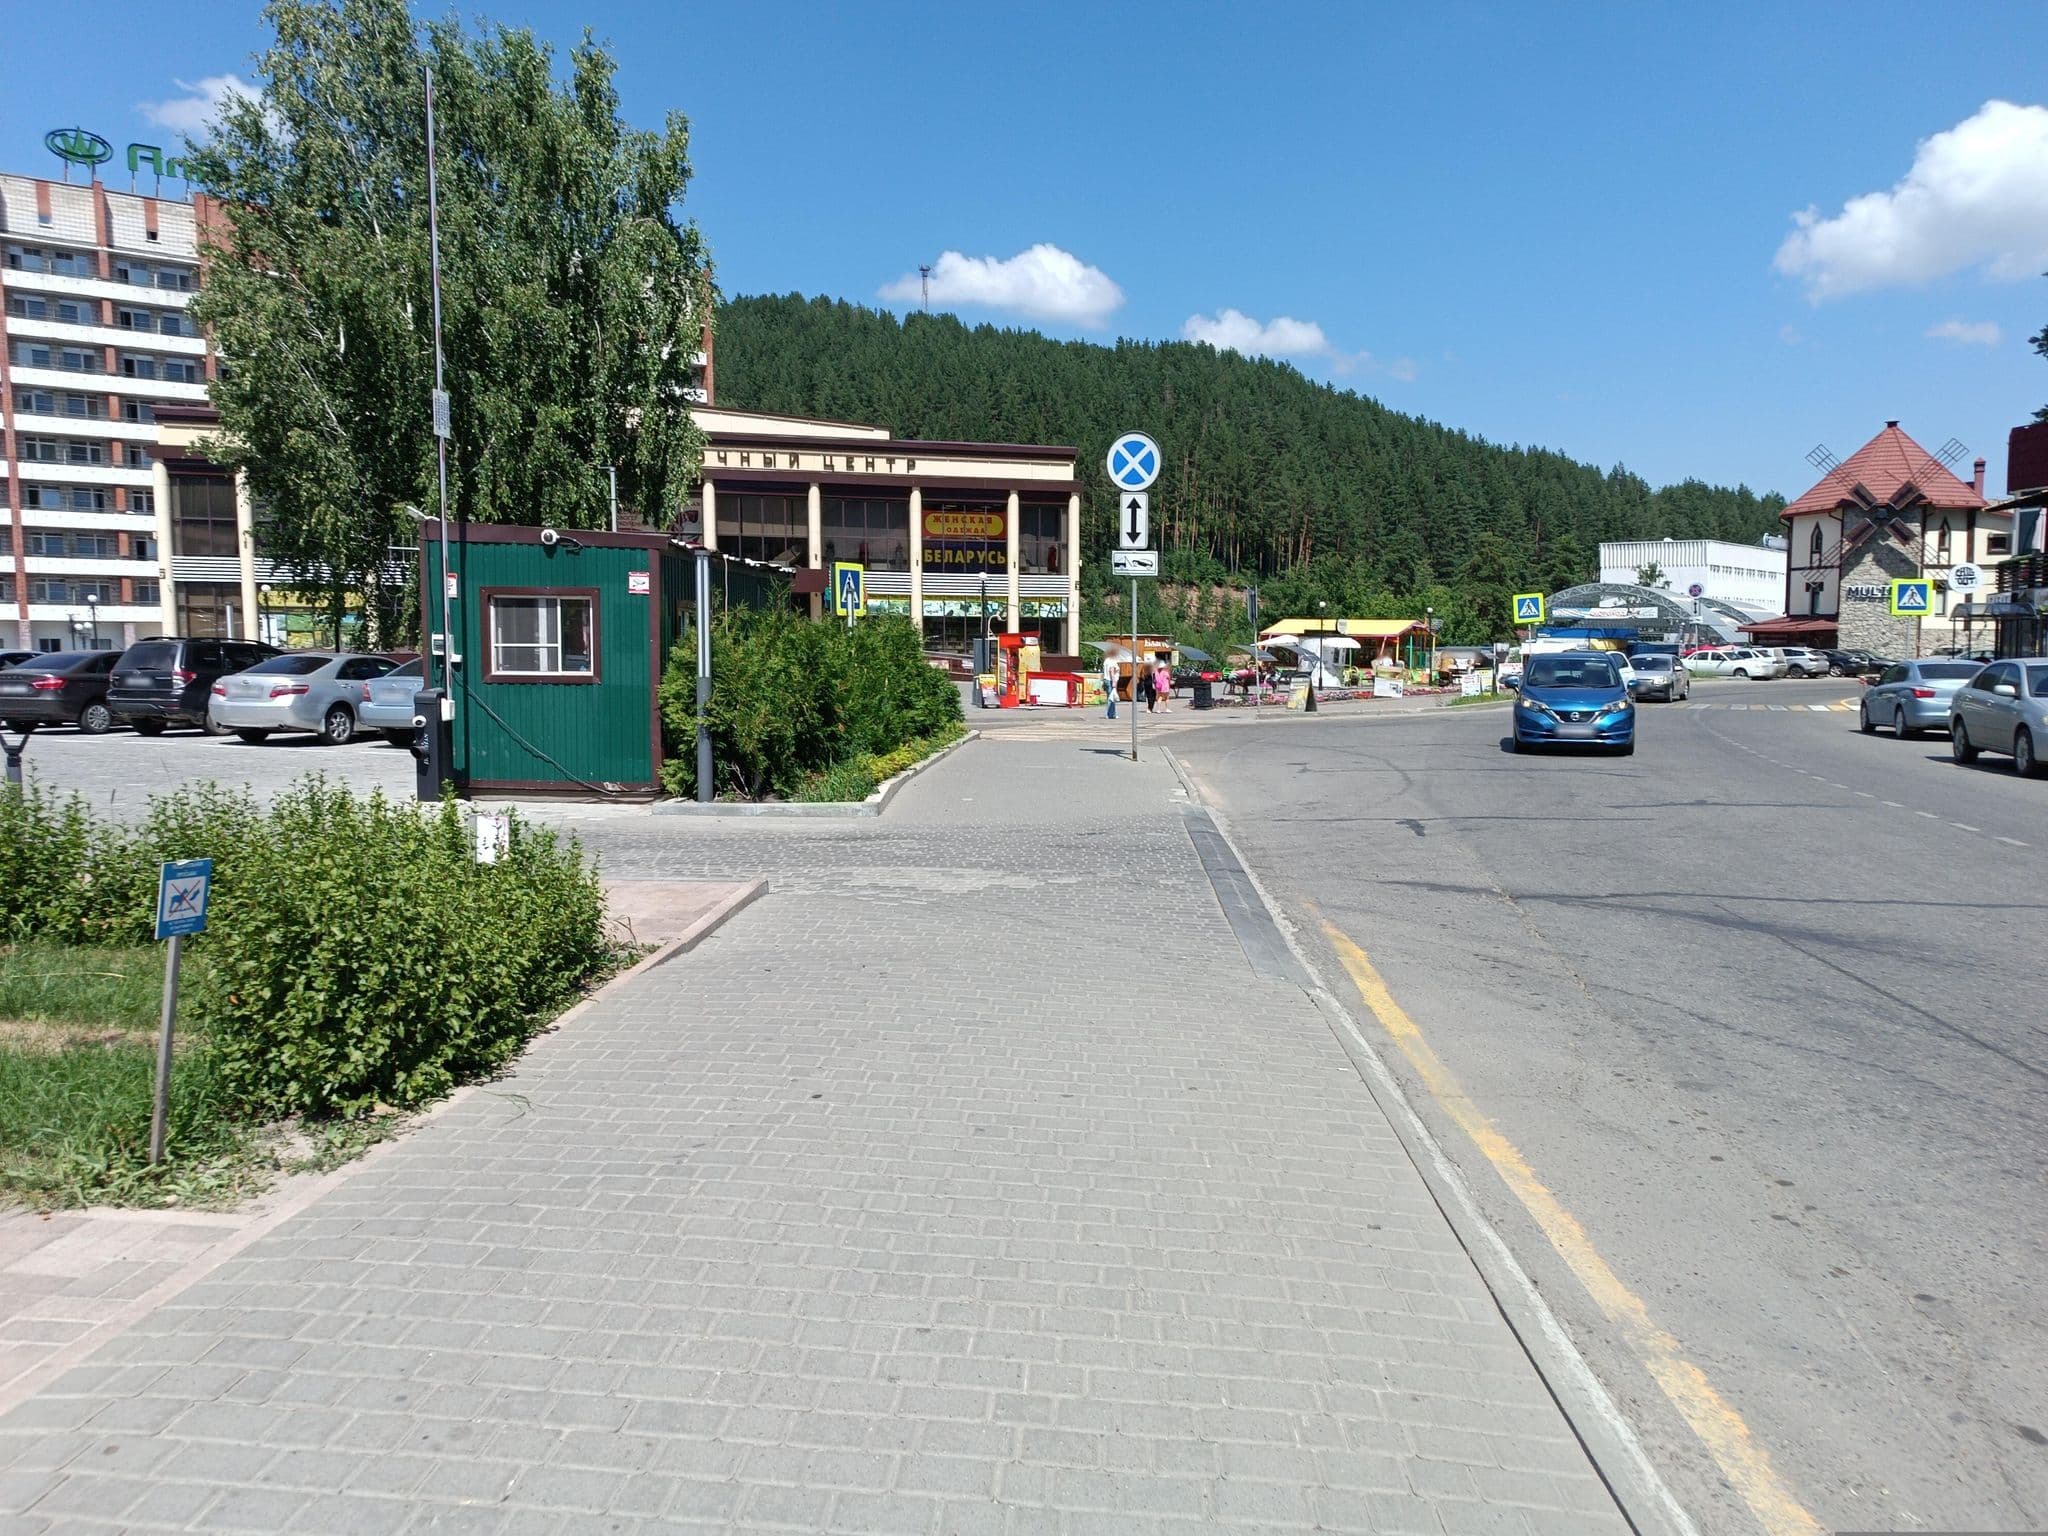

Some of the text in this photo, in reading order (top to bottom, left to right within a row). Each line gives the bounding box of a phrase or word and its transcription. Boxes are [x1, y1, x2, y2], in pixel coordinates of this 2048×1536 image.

[823, 455, 916, 474] ЦЕНТР
[932, 514, 993, 525] ЖЕНСКАЯ
[946, 526, 987, 535] ОДЕЖДА
[923, 549, 1006, 565] БЕЛАРУСЬ
